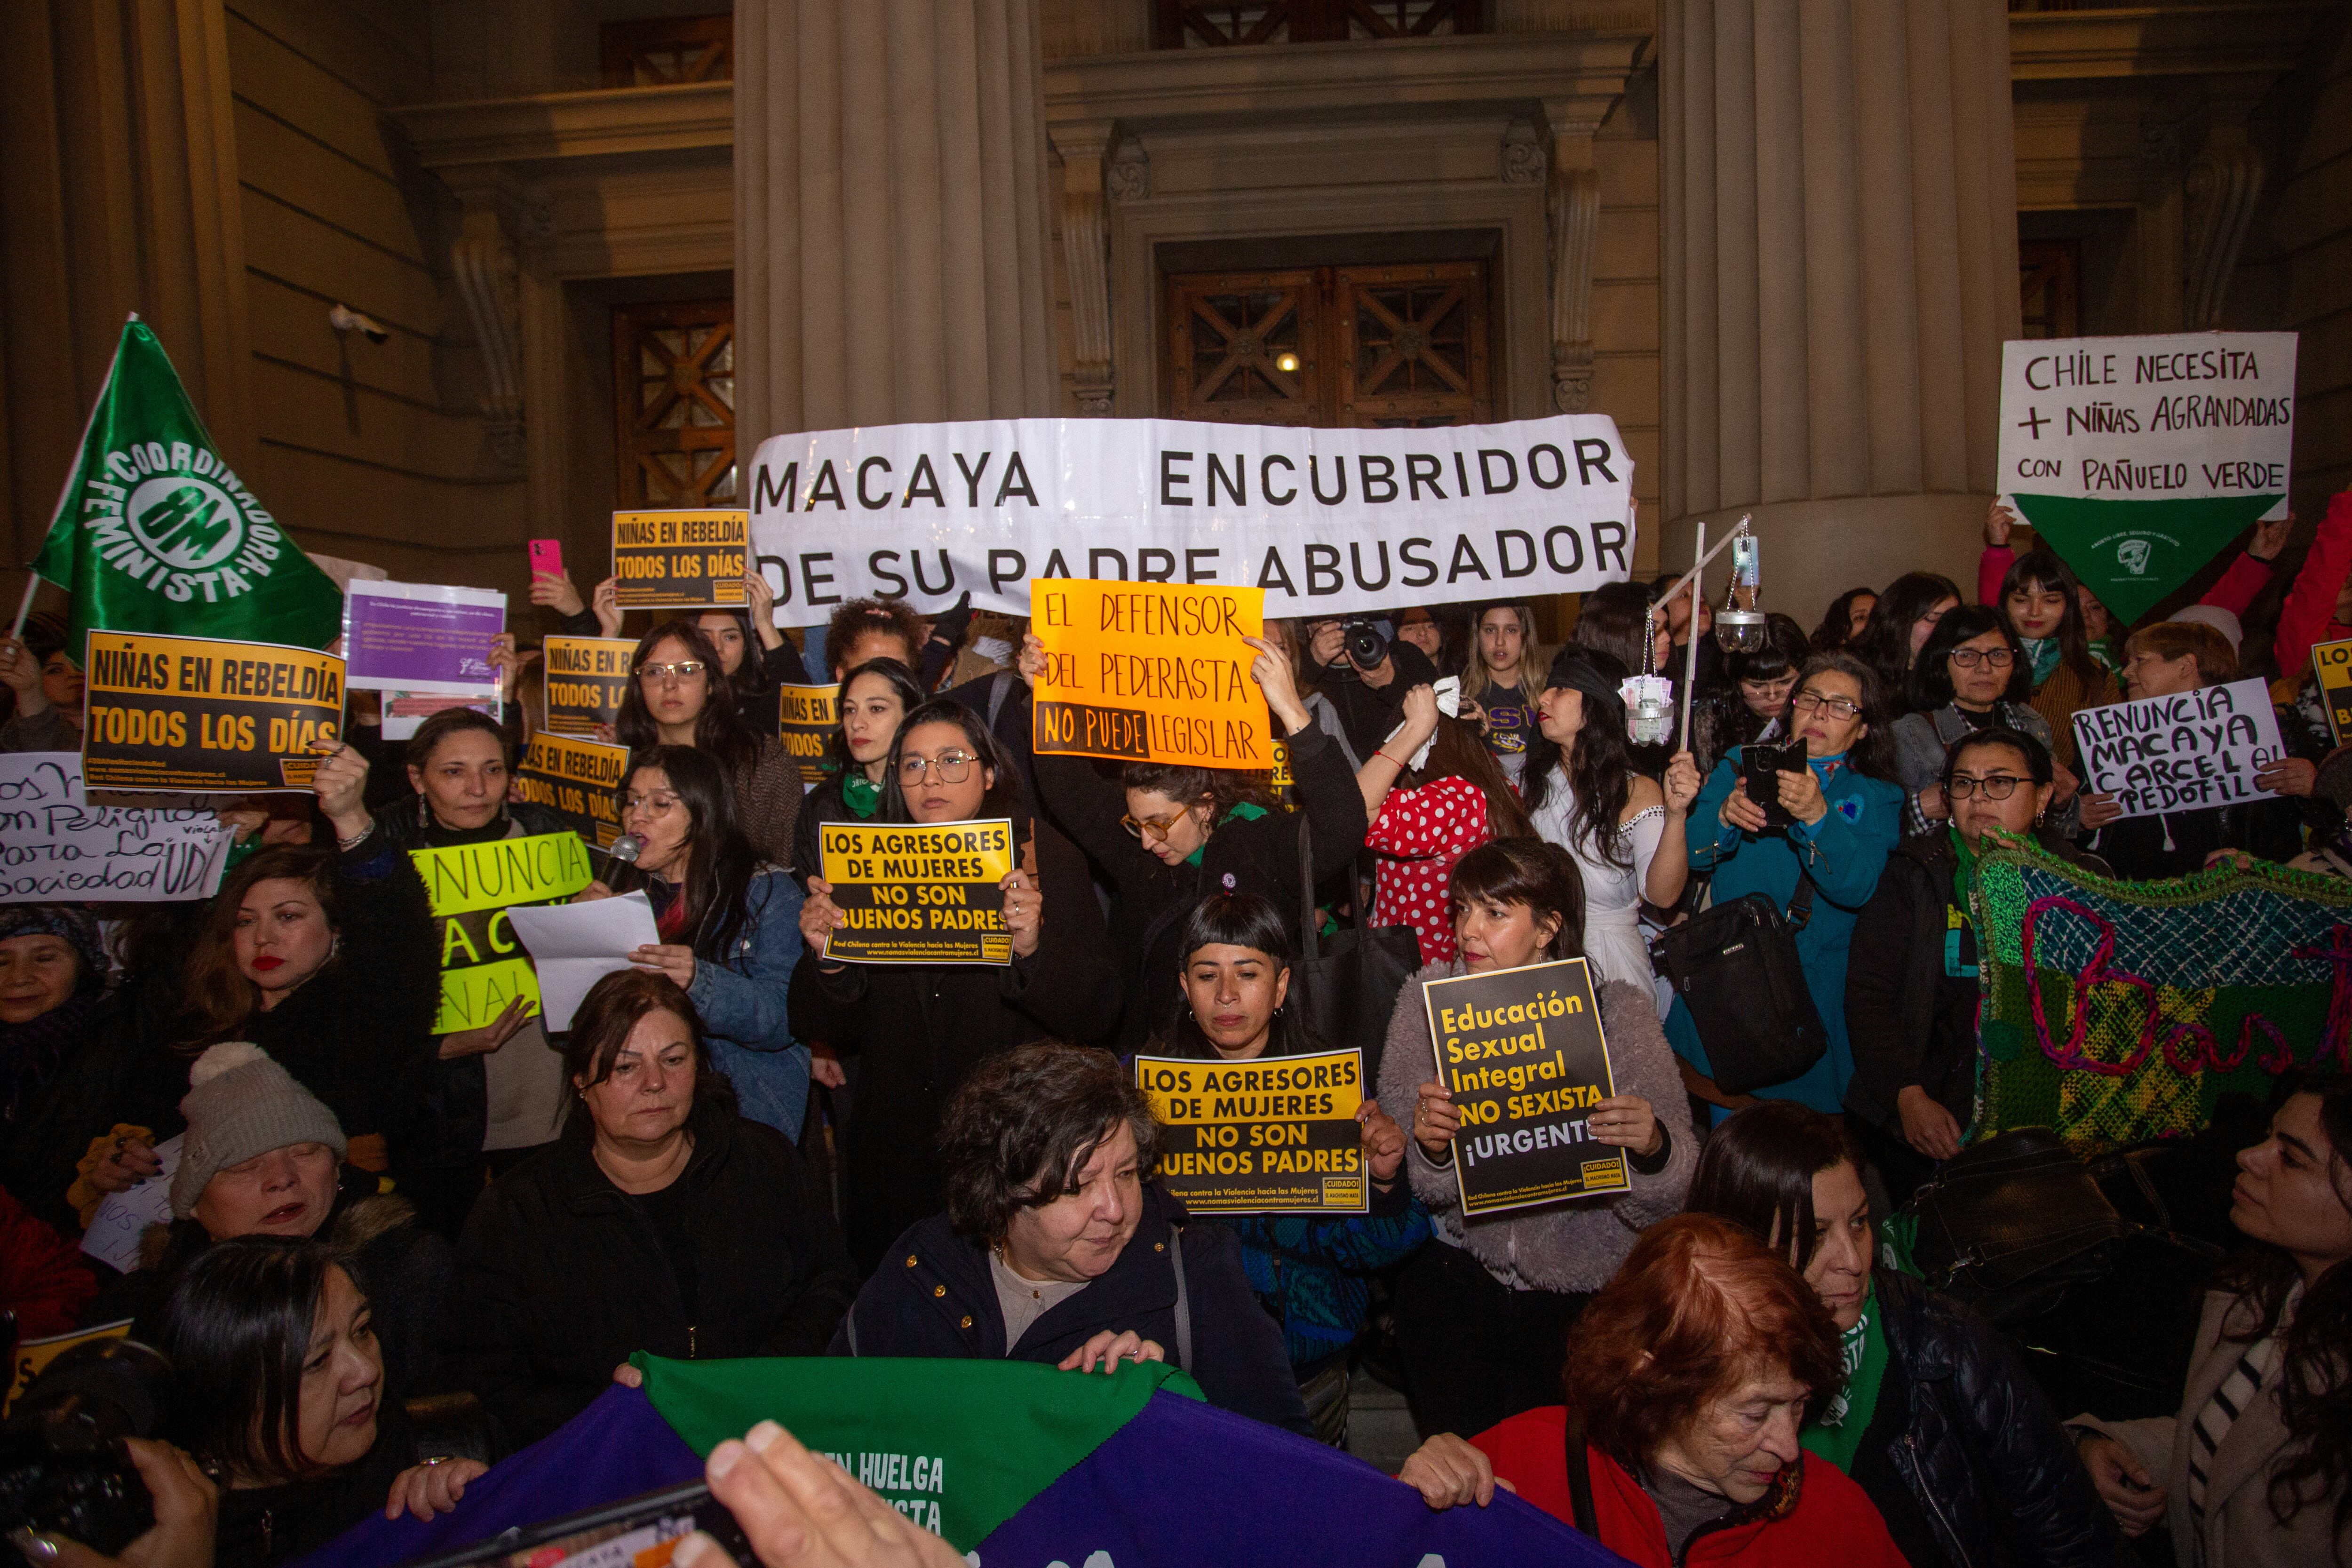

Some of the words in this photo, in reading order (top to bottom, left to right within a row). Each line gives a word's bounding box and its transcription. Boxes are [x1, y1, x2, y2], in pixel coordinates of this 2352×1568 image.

[2025, 350, 2117, 390] CHILE
[2136, 348, 2259, 384] NECESITA
[2066, 401, 2140, 436] NIÑAS
[2150, 395, 2291, 433] AGRANDADAS
[754, 450, 1040, 515] MACAYA
[1160, 438, 1619, 507] ENCUBRIDOR
[2018, 458, 2062, 478] CON
[2082, 458, 2187, 491] PAÑUELO
[2202, 461, 2284, 489] VERDE
[107, 442, 281, 577] COORDINADORA
[84, 480, 253, 603] FEMINISTA
[617, 517, 656, 545] NIÑAS
[660, 523, 676, 543] EN
[682, 515, 745, 543] REBELDÍA
[615, 555, 665, 581] TODOS
[672, 554, 701, 578] LOS
[707, 549, 744, 579] DÍAS
[756, 552, 842, 608] DE
[868, 549, 955, 601] SU
[1259, 521, 1628, 598] ABUSADOR
[1046, 593, 1073, 627] EL
[1101, 593, 1244, 638] DEFENSOR
[94, 643, 169, 690] NIÑAS
[179, 656, 211, 692] EN
[221, 661, 339, 705] REBELDÍA
[549, 643, 590, 671] NIÑAS
[596, 650, 615, 673] EN
[2320, 647, 2352, 666] LO
[548, 682, 602, 708] TODOS
[1046, 652, 1084, 689] DEL
[1102, 653, 1247, 704] PEDERASTA
[782, 690, 808, 721] NIÑAS
[810, 698, 829, 721] EN
[2073, 685, 2234, 745] RENUNCIA
[90, 706, 188, 748] TODOS
[200, 713, 256, 752] LOS
[269, 710, 337, 756] DÍAS
[1044, 706, 1074, 743] NO
[1086, 708, 1145, 755] PUEDE
[1149, 714, 1259, 761] LEGISLAR
[2091, 714, 2258, 773] MACAYA
[564, 749, 621, 785] REBELDÍA
[2097, 750, 2241, 793] CARCEL
[518, 777, 556, 807] ODOS
[558, 786, 585, 814] LOS
[0, 843, 99, 866] ara
[826, 833, 863, 854] LOS
[872, 829, 1006, 855] AGRESORES
[432, 836, 587, 904] NUNCIA
[847, 859, 874, 879] DE
[882, 858, 984, 879] MUJERES
[872, 885, 908, 906] NO
[917, 885, 966, 905] SON
[1440, 990, 1583, 1034] Educación
[1446, 1022, 1546, 1064] Sexual
[1144, 1068, 1192, 1093] LOS
[1202, 1061, 1356, 1093] AGRESORES
[1451, 1050, 1566, 1093] Integral
[1170, 1098, 1202, 1119] DE
[1213, 1093, 1334, 1118] MUJERES
[1458, 1100, 1500, 1127] NO
[1508, 1084, 1603, 1120] SEXISTA
[1196, 1126, 1239, 1148] NO
[1249, 1124, 1308, 1146] SON
[1262, 1148, 1359, 1175] PADRES
[1584, 1162, 1620, 1173] ¡CUIDADO!
[1185, 1195, 1319, 1205] www.nomasviolenciacontramujeres.cl
[1257, 1187, 1276, 1195] hacia
[1290, 1186, 1319, 1196] Mujeres
[1324, 1180, 1359, 1189] ¡CUIDADO!
[1518, 1185, 1541, 1194] Violencia
[1563, 1178, 1582, 1187] Mujeres
[859, 1452, 943, 1494] HUELGA
